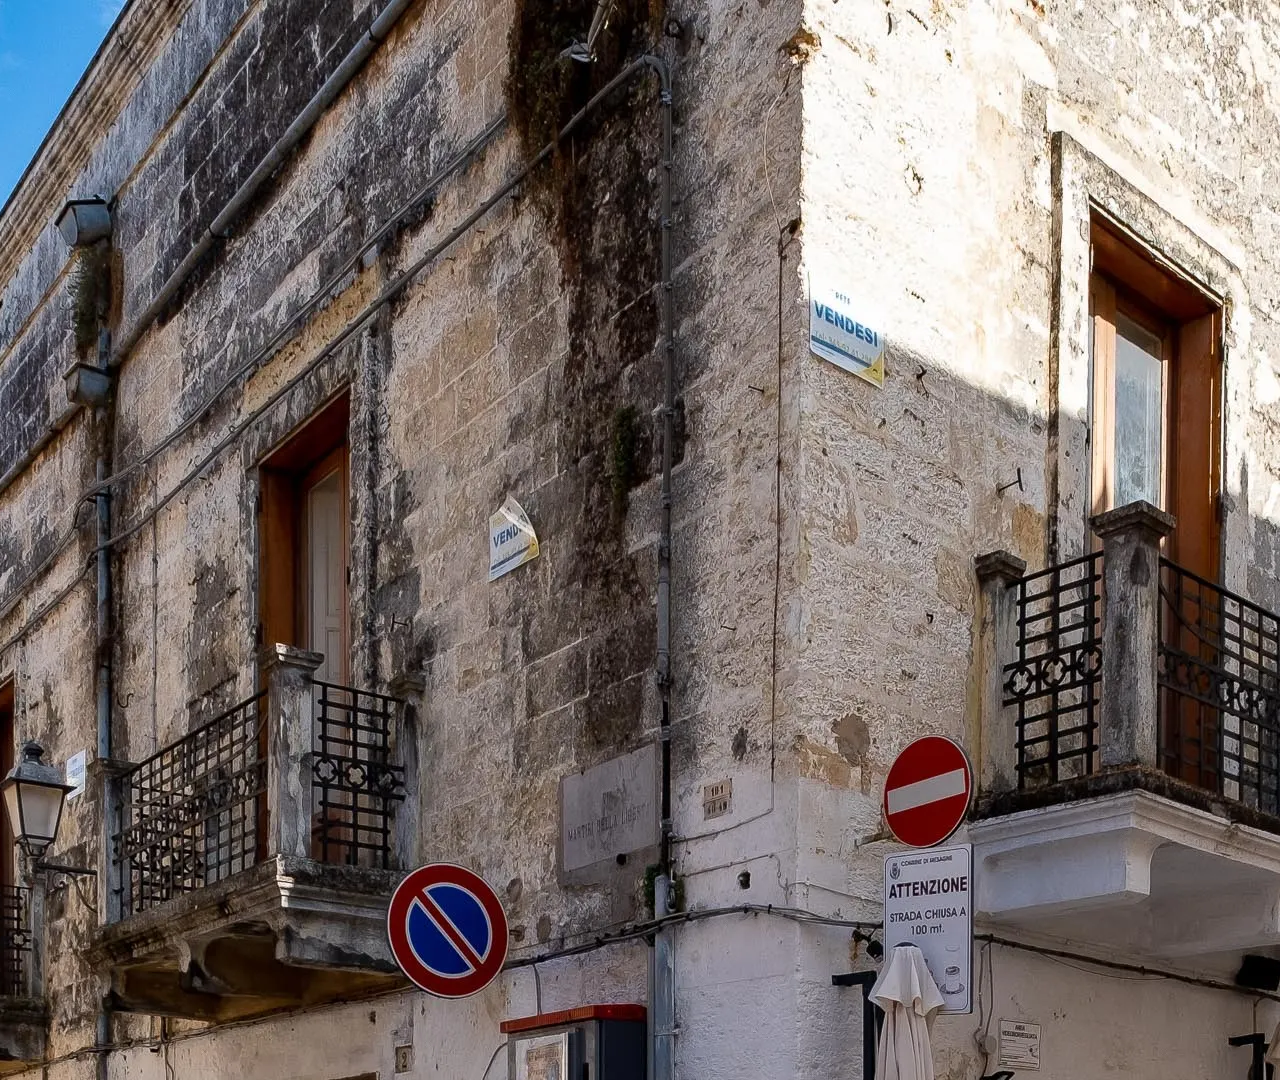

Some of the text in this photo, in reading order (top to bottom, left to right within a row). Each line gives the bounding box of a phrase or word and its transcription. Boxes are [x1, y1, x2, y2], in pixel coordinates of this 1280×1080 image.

[814, 300, 878, 347] VENDESI
[493, 523, 522, 548] VEND
[888, 875, 968, 899] ATTENZIONE
[889, 906, 967, 923] STRADA CHIUSA A
[911, 923, 945, 935] 100 mt.
[401, 1051, 408, 1069] 2
